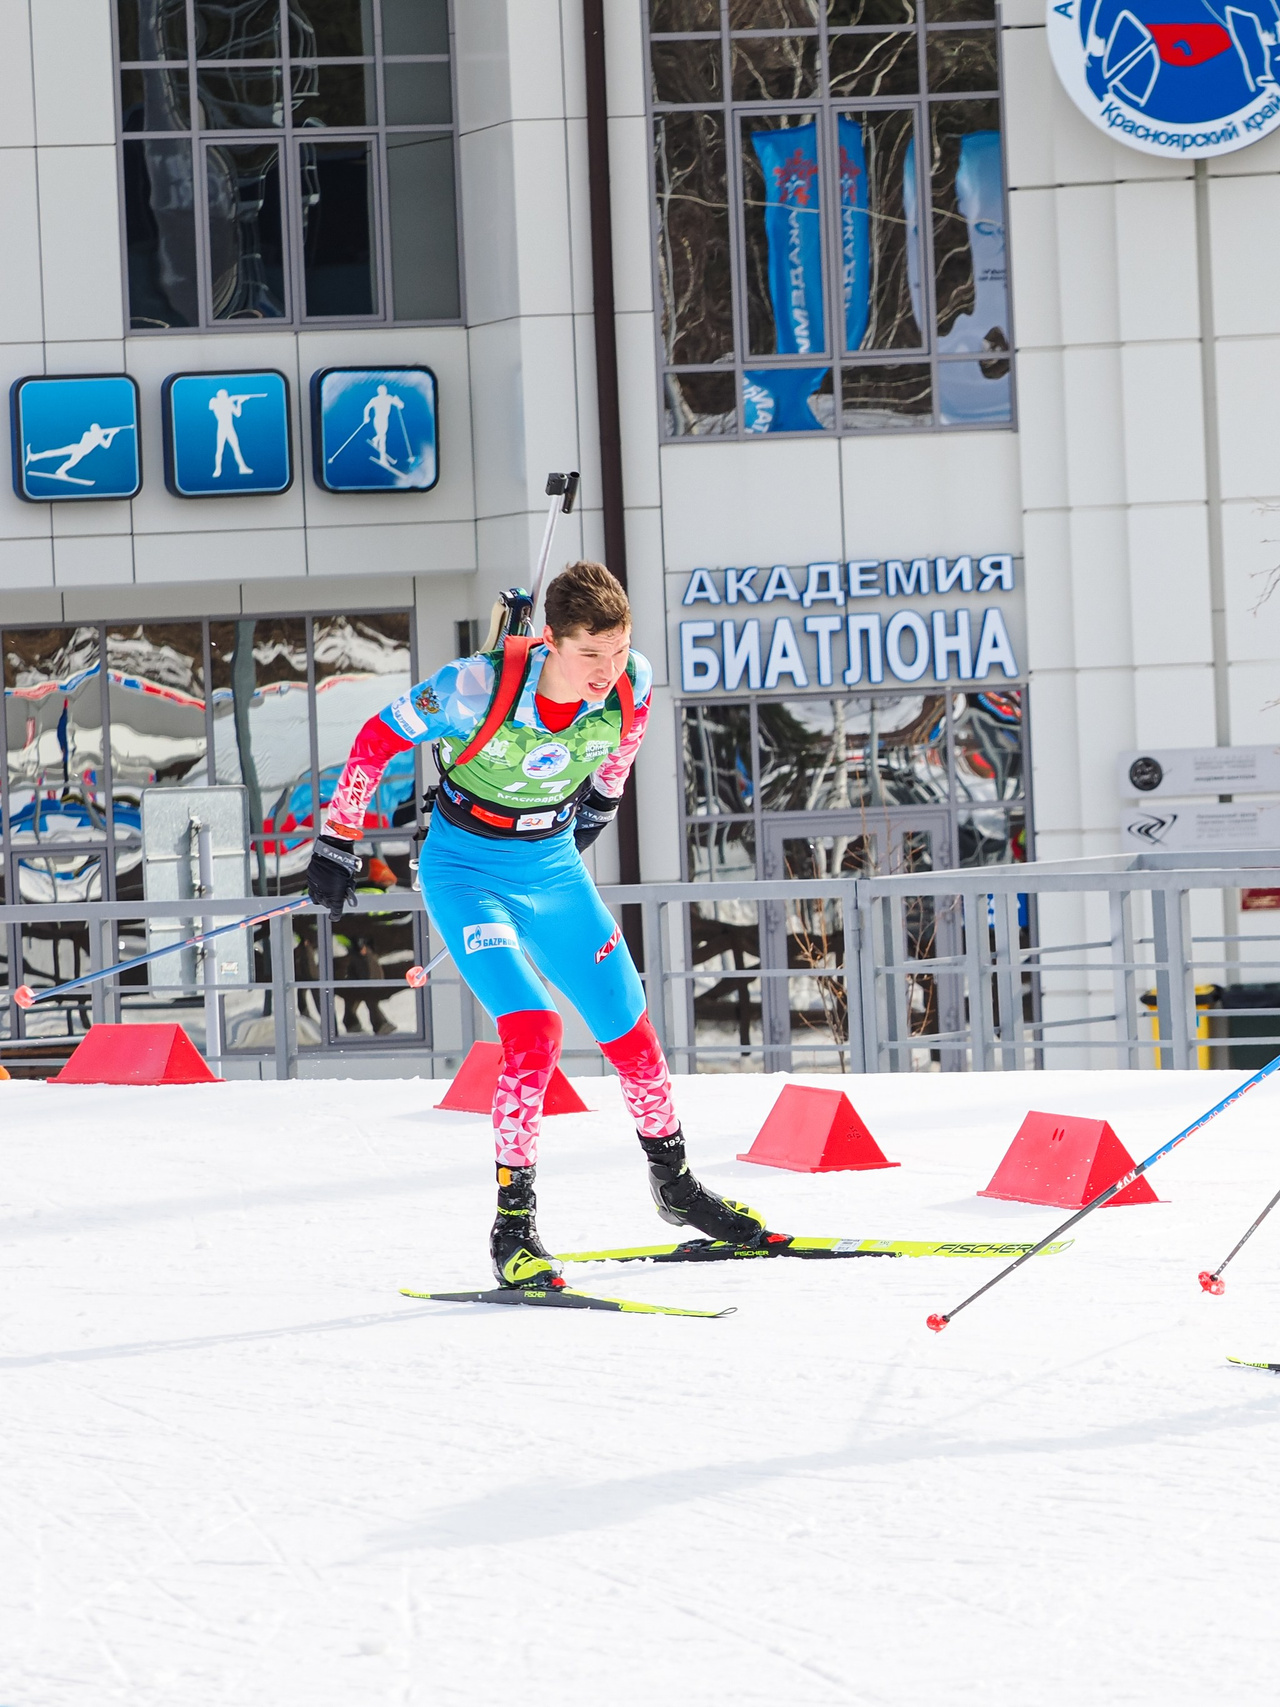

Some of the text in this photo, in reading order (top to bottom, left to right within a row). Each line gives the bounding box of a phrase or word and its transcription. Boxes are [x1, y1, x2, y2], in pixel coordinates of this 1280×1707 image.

[1101, 101, 1240, 151] Красноярский
[682, 553, 1016, 609] АКАДЕМИЯ
[679, 607, 1020, 693] БИАТЛОНА
[483, 937, 517, 947] GAZPROM
[934, 1243, 1034, 1254] FISCHER
